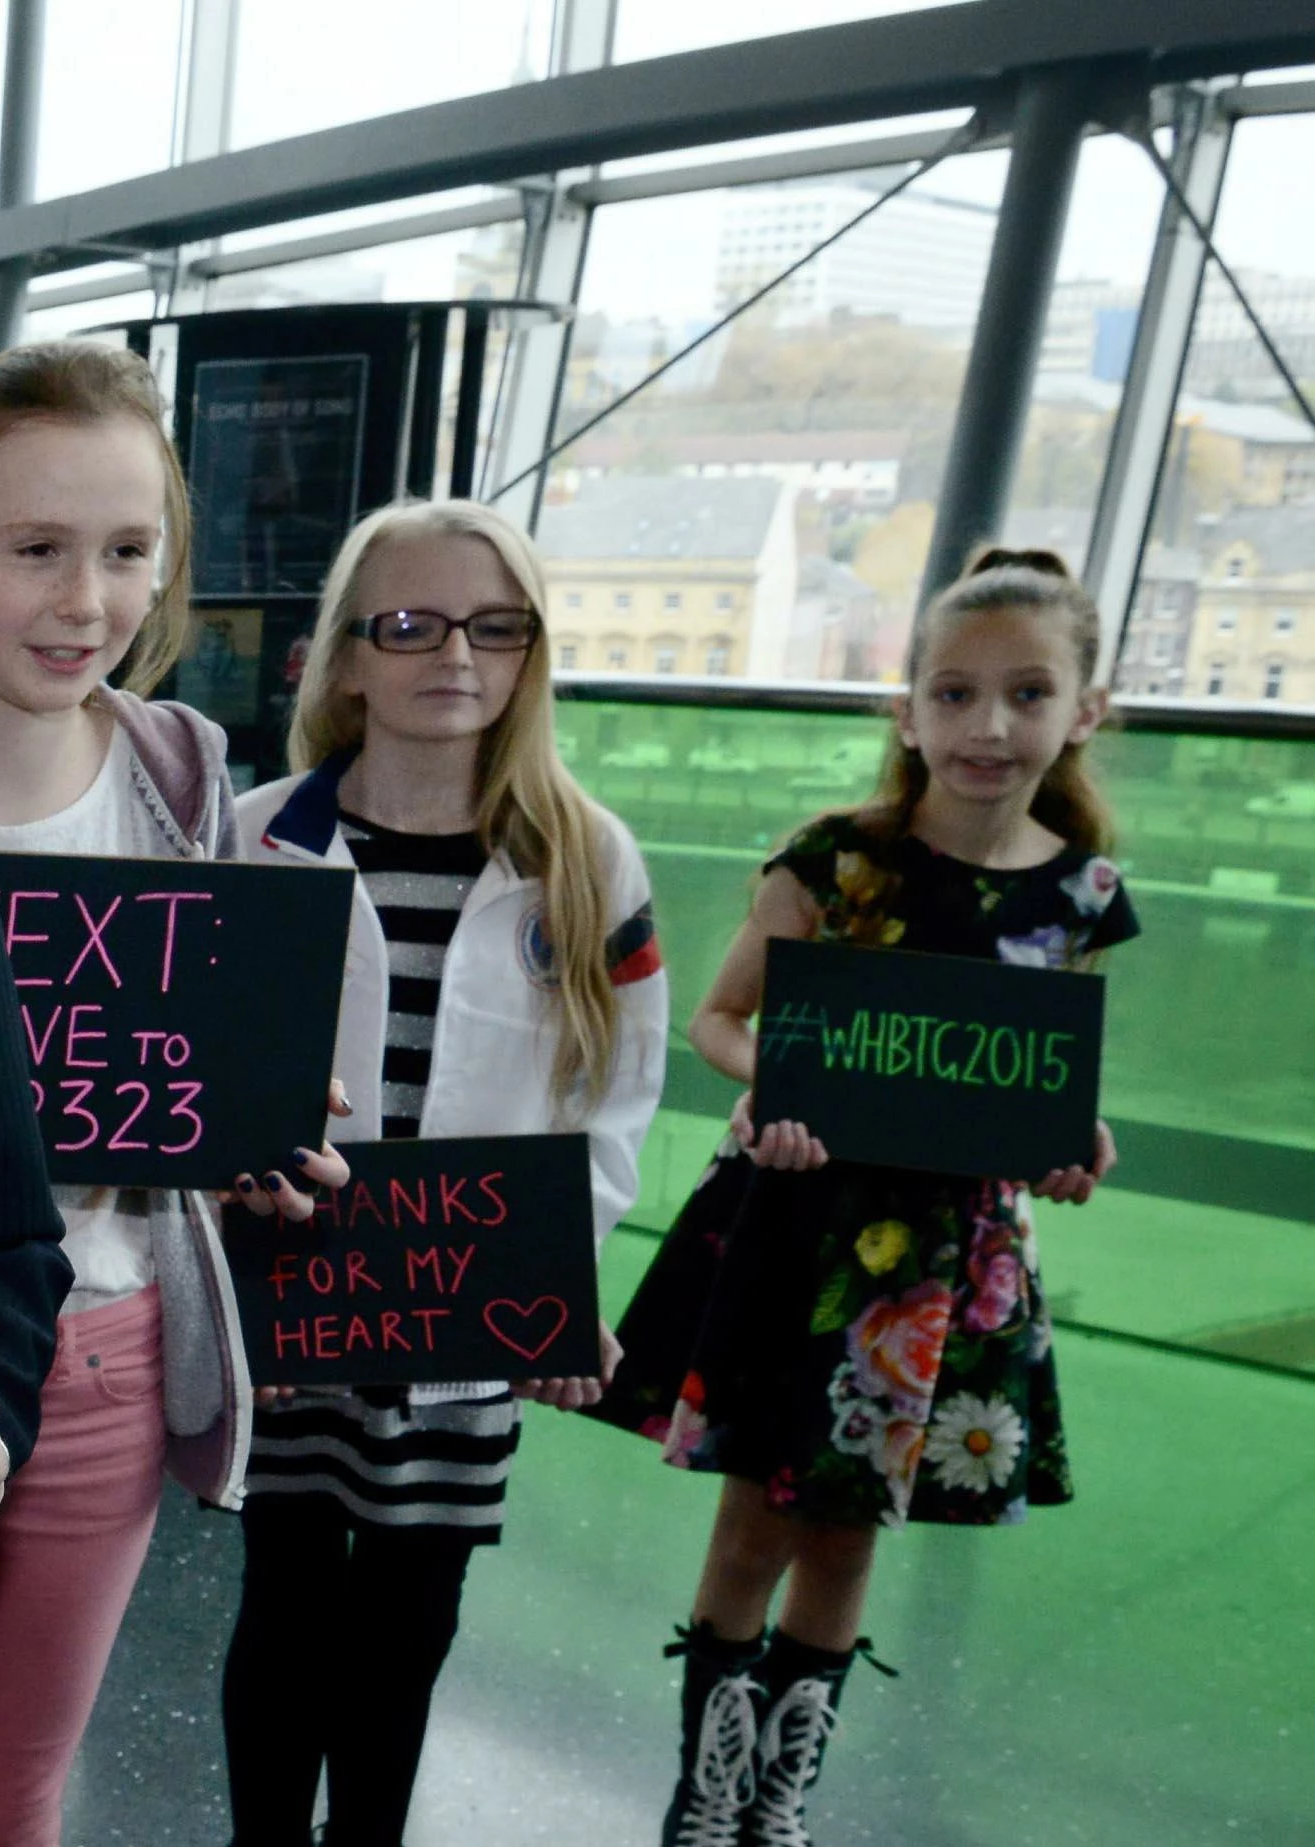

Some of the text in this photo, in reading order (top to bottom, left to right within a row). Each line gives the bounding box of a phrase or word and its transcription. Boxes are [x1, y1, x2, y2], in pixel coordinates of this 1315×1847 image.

[131, 1032, 191, 1068] TO
[759, 1002, 1075, 1092] #WHBTG2015
[274, 1170, 508, 1230] HANKS
[267, 1243, 476, 1301] FOR MY
[274, 1308, 452, 1360] HEART
